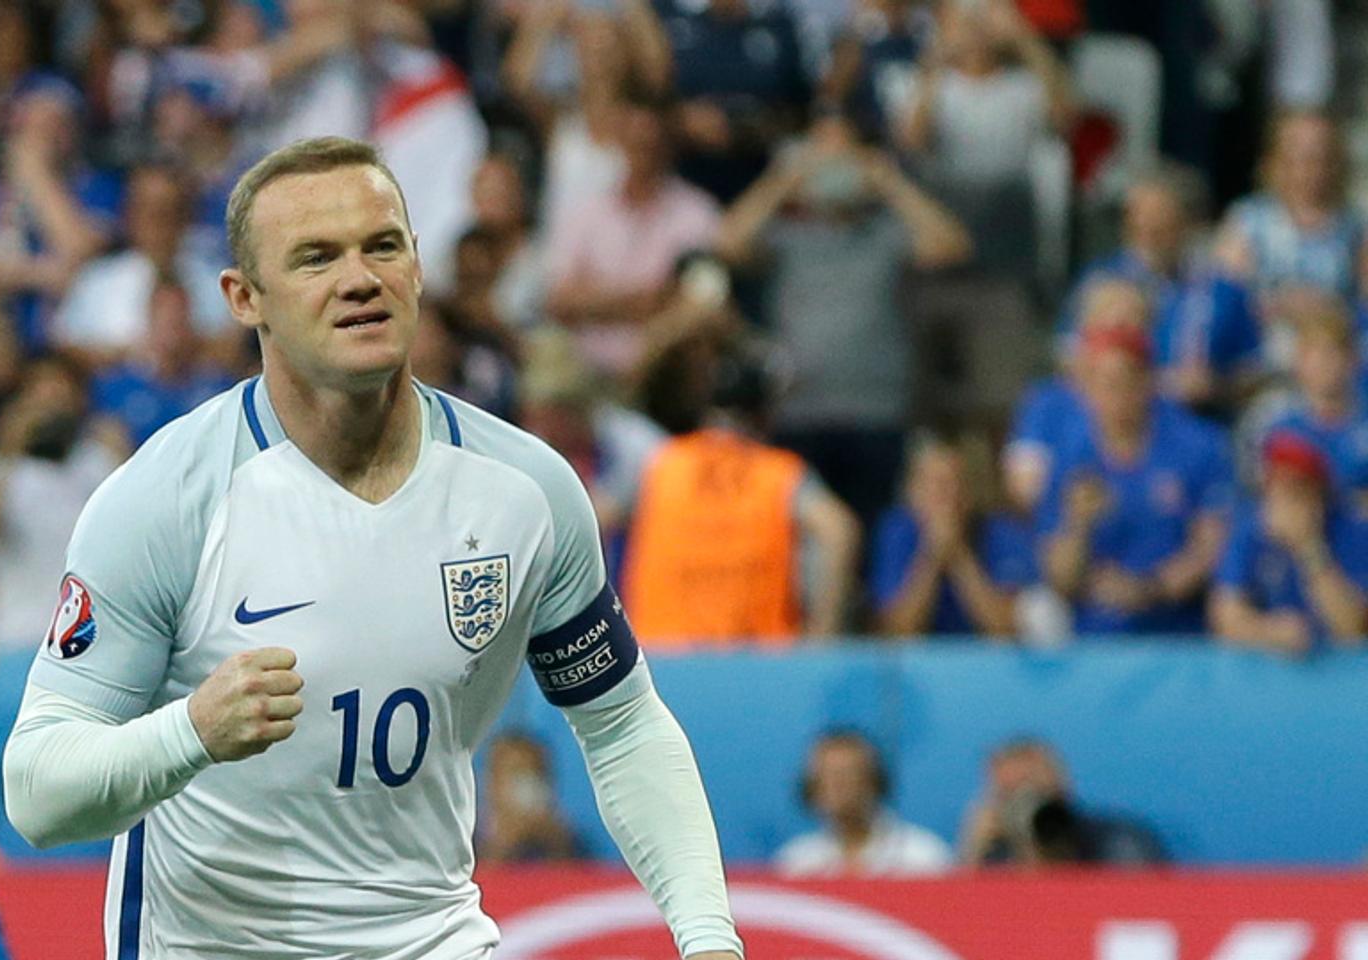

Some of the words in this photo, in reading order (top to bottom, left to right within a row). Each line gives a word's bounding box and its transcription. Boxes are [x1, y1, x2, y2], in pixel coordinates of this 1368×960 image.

[535, 652, 555, 665] TO
[556, 619, 610, 661] RACISM
[551, 646, 614, 686] RESPECT
[332, 687, 431, 788] 10
